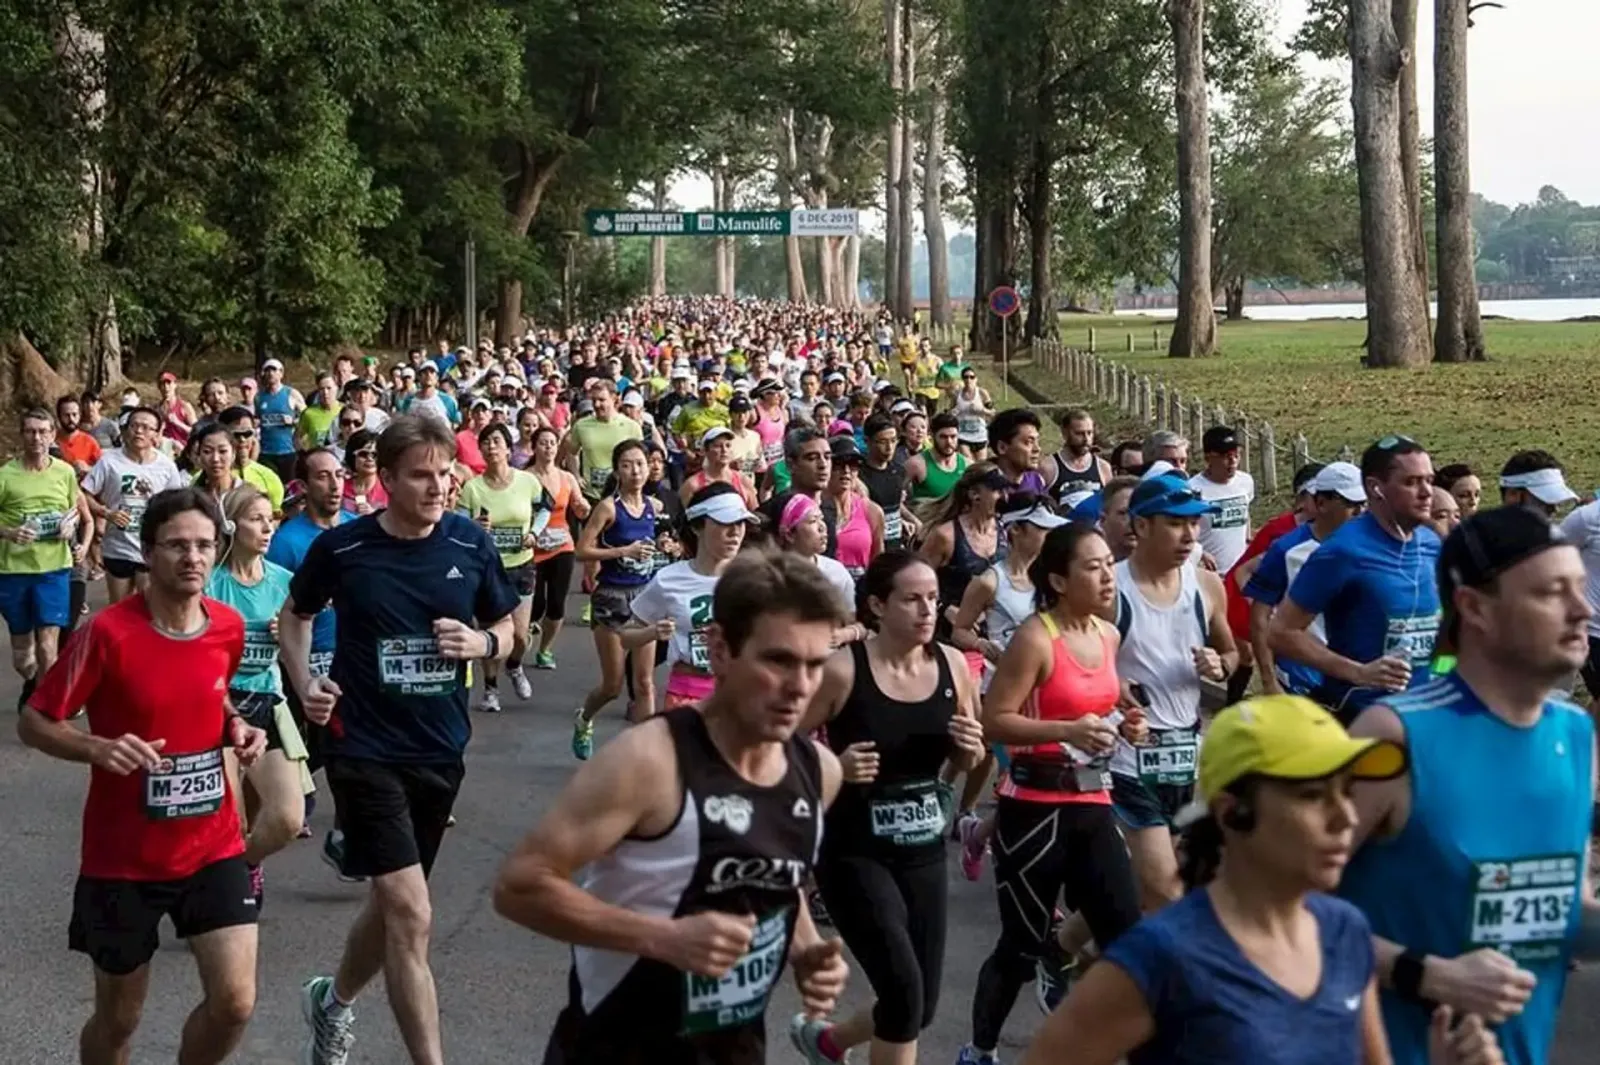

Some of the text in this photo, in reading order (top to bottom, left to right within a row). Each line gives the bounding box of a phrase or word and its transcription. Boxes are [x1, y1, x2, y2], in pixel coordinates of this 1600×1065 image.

[717, 216, 783, 231] Manulife
[798, 213, 854, 223] 6 DEC 2015
[384, 657, 457, 675] M-1628
